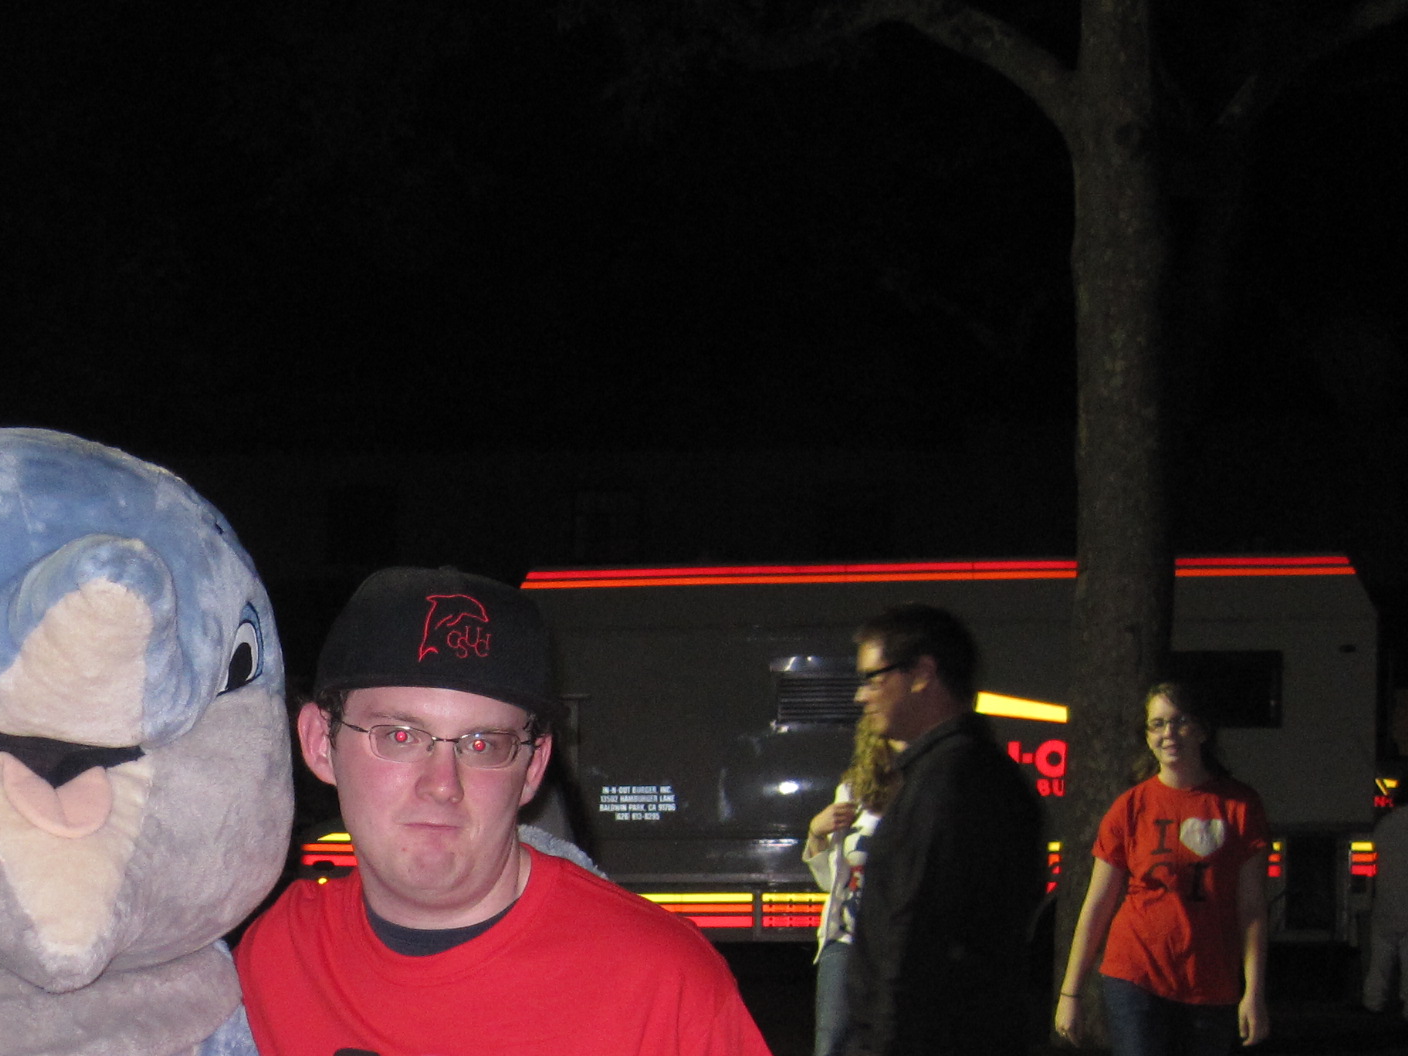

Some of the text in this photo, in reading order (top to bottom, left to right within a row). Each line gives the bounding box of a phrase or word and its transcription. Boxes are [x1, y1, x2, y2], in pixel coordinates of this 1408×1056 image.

[659, 795, 675, 803] LANE
[647, 803, 657, 812] CA
[1151, 818, 1175, 855] I
